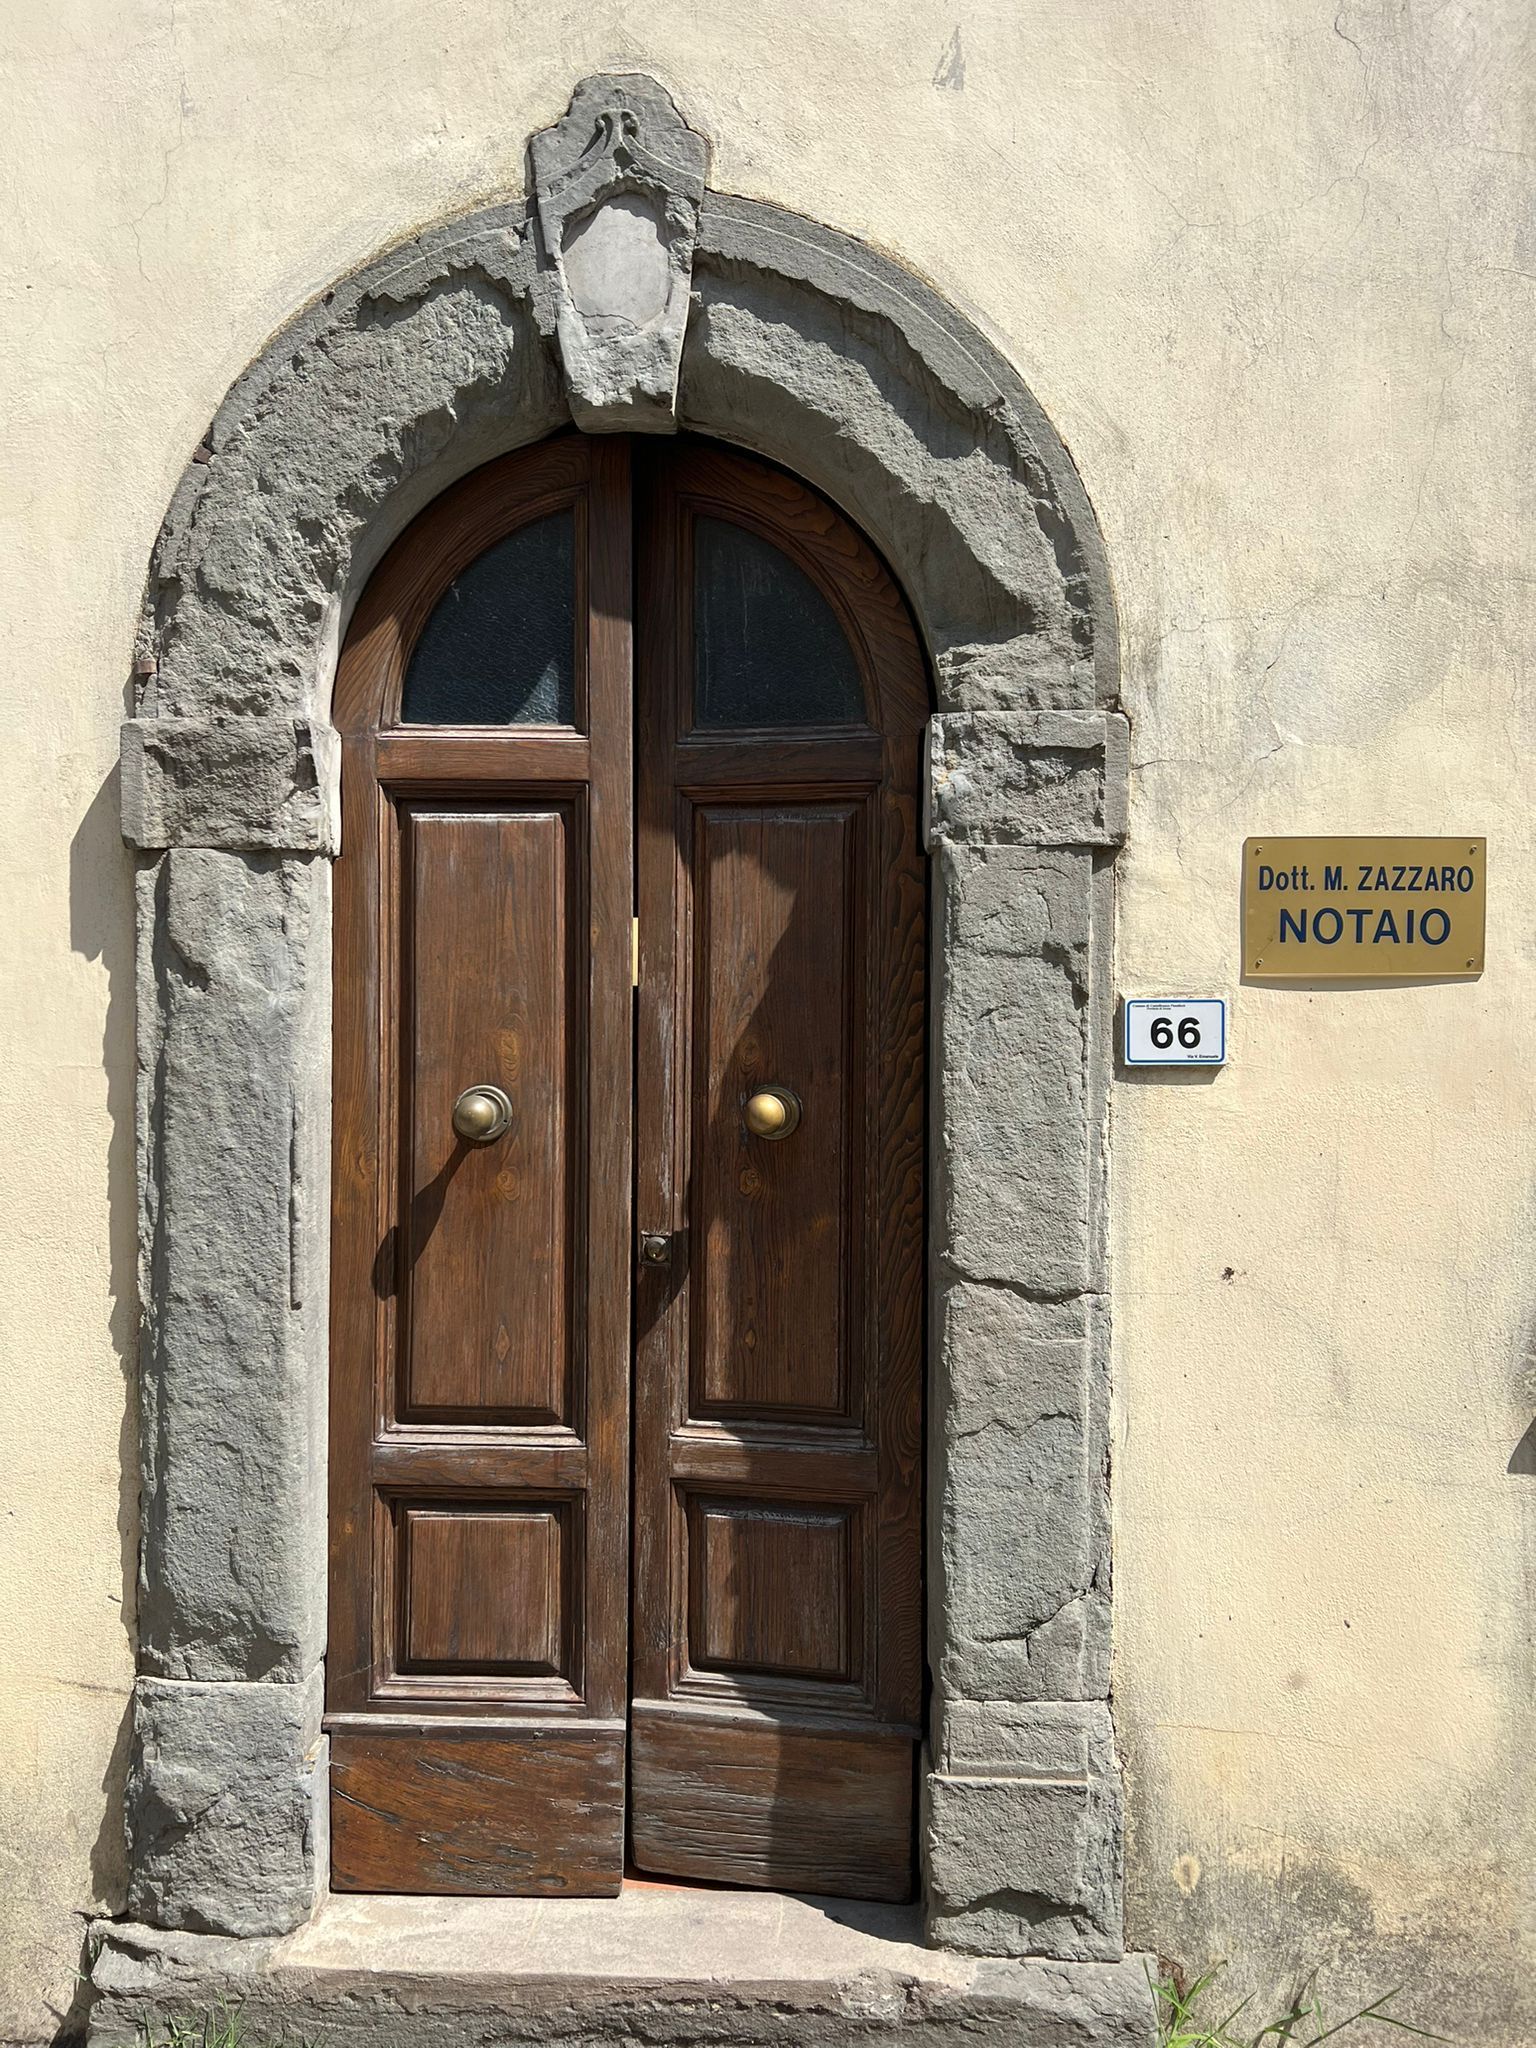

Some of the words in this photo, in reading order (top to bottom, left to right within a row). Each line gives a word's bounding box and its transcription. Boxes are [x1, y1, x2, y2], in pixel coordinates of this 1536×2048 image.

[1259, 865, 1315, 891] Dott.
[1324, 866, 1348, 891] M.
[1358, 865, 1474, 892] ZAZZARO
[1279, 907, 1451, 945] NOTAIO
[1150, 1017, 1201, 1049] 66
